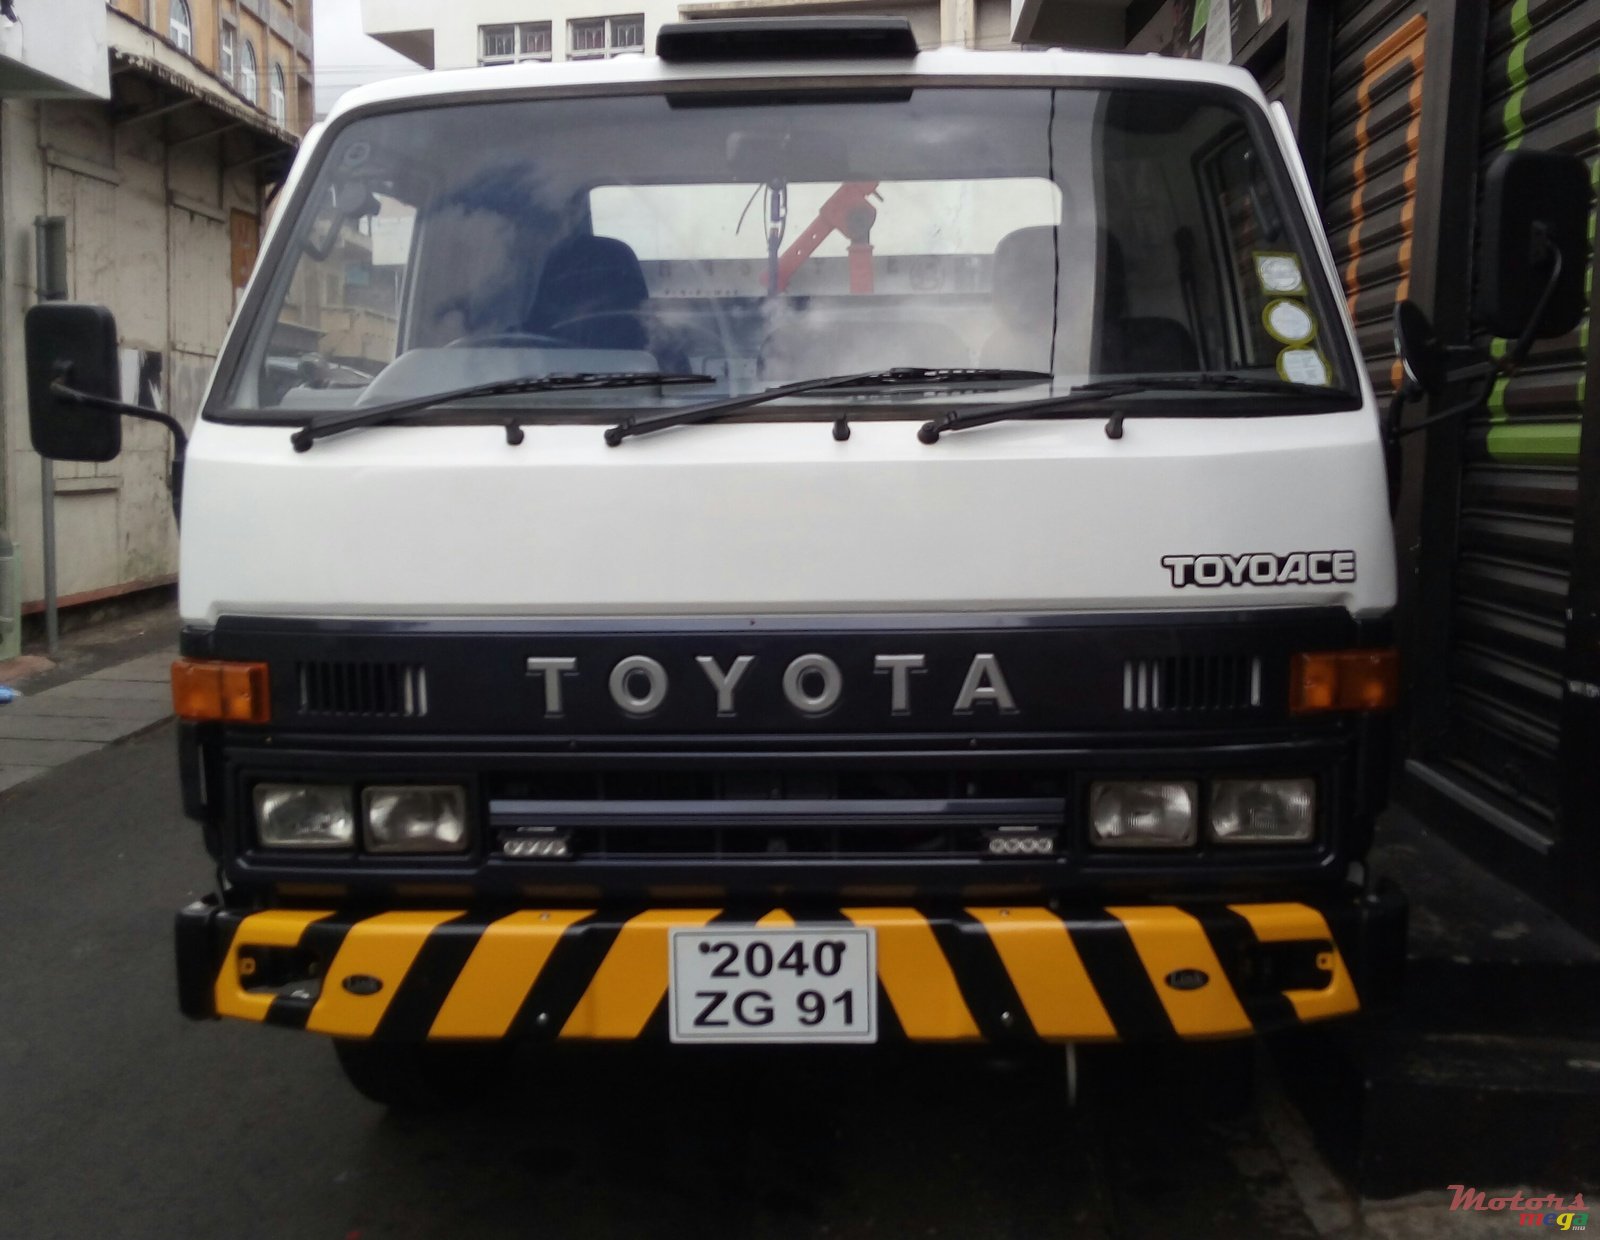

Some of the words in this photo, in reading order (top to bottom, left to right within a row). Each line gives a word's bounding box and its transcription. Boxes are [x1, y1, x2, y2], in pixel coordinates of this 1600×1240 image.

[1161, 550, 1357, 588] TOYOACE
[525, 653, 1020, 718] TOYOTA
[709, 940, 845, 978] 2040
[693, 990, 775, 1027] ZG
[796, 989, 854, 1026] 91
